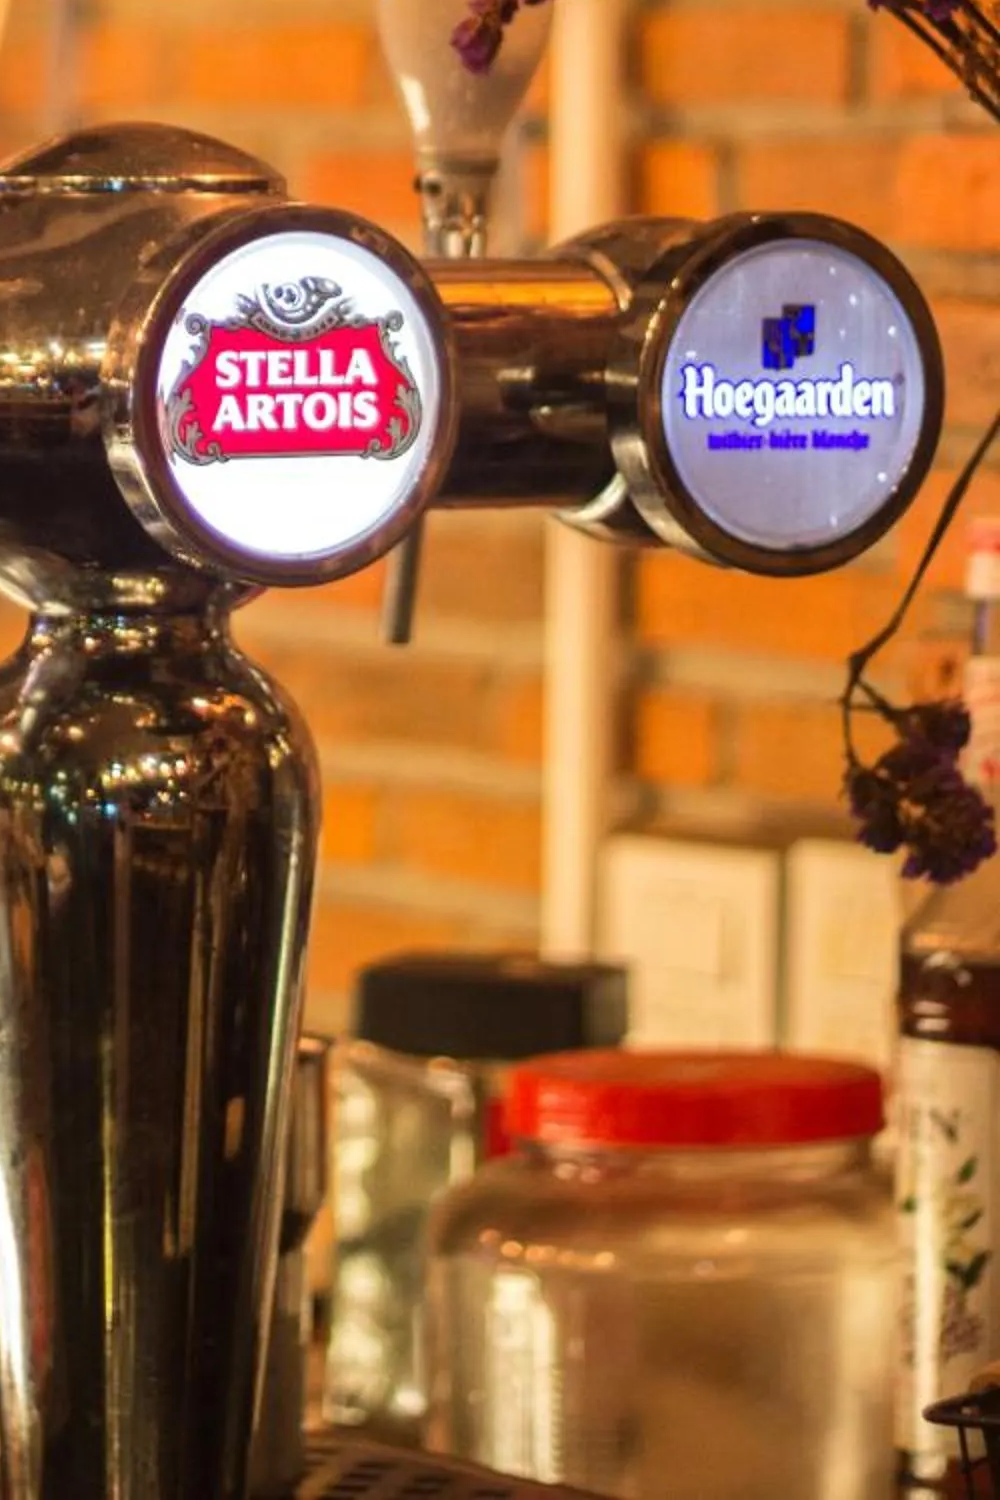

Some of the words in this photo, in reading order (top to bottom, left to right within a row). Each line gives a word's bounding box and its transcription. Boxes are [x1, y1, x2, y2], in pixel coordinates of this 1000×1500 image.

[214, 349, 378, 388] STELLA
[211, 391, 380, 432] ARTOIS
[680, 363, 896, 427] Hoegaarden
